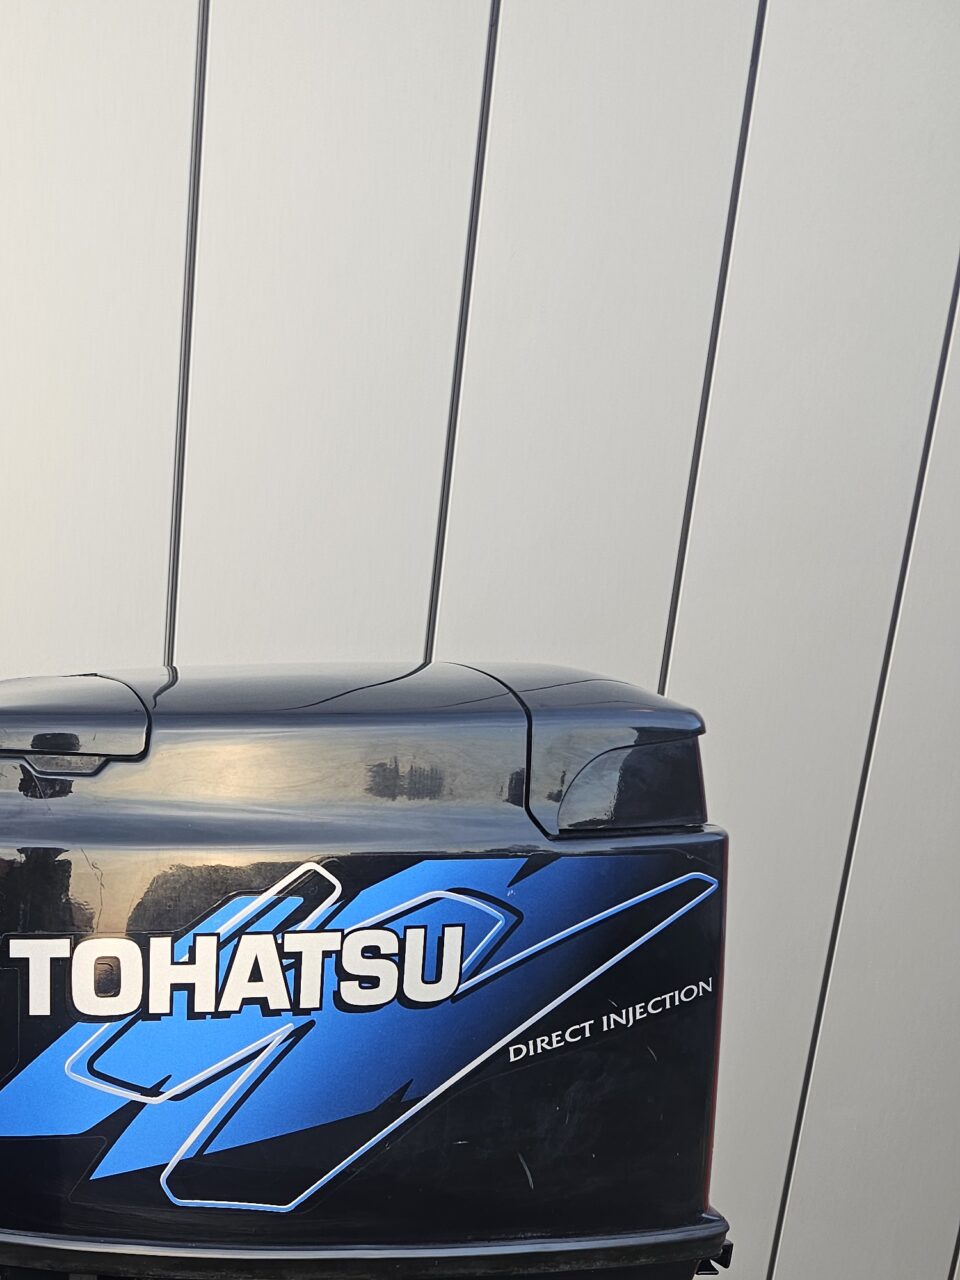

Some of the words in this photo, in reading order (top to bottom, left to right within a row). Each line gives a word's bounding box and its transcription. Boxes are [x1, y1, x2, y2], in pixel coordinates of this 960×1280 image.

[8, 926, 463, 1017] TOHATSU
[508, 1020, 594, 1063] DIRECT
[602, 977, 713, 1032] INJECTION
